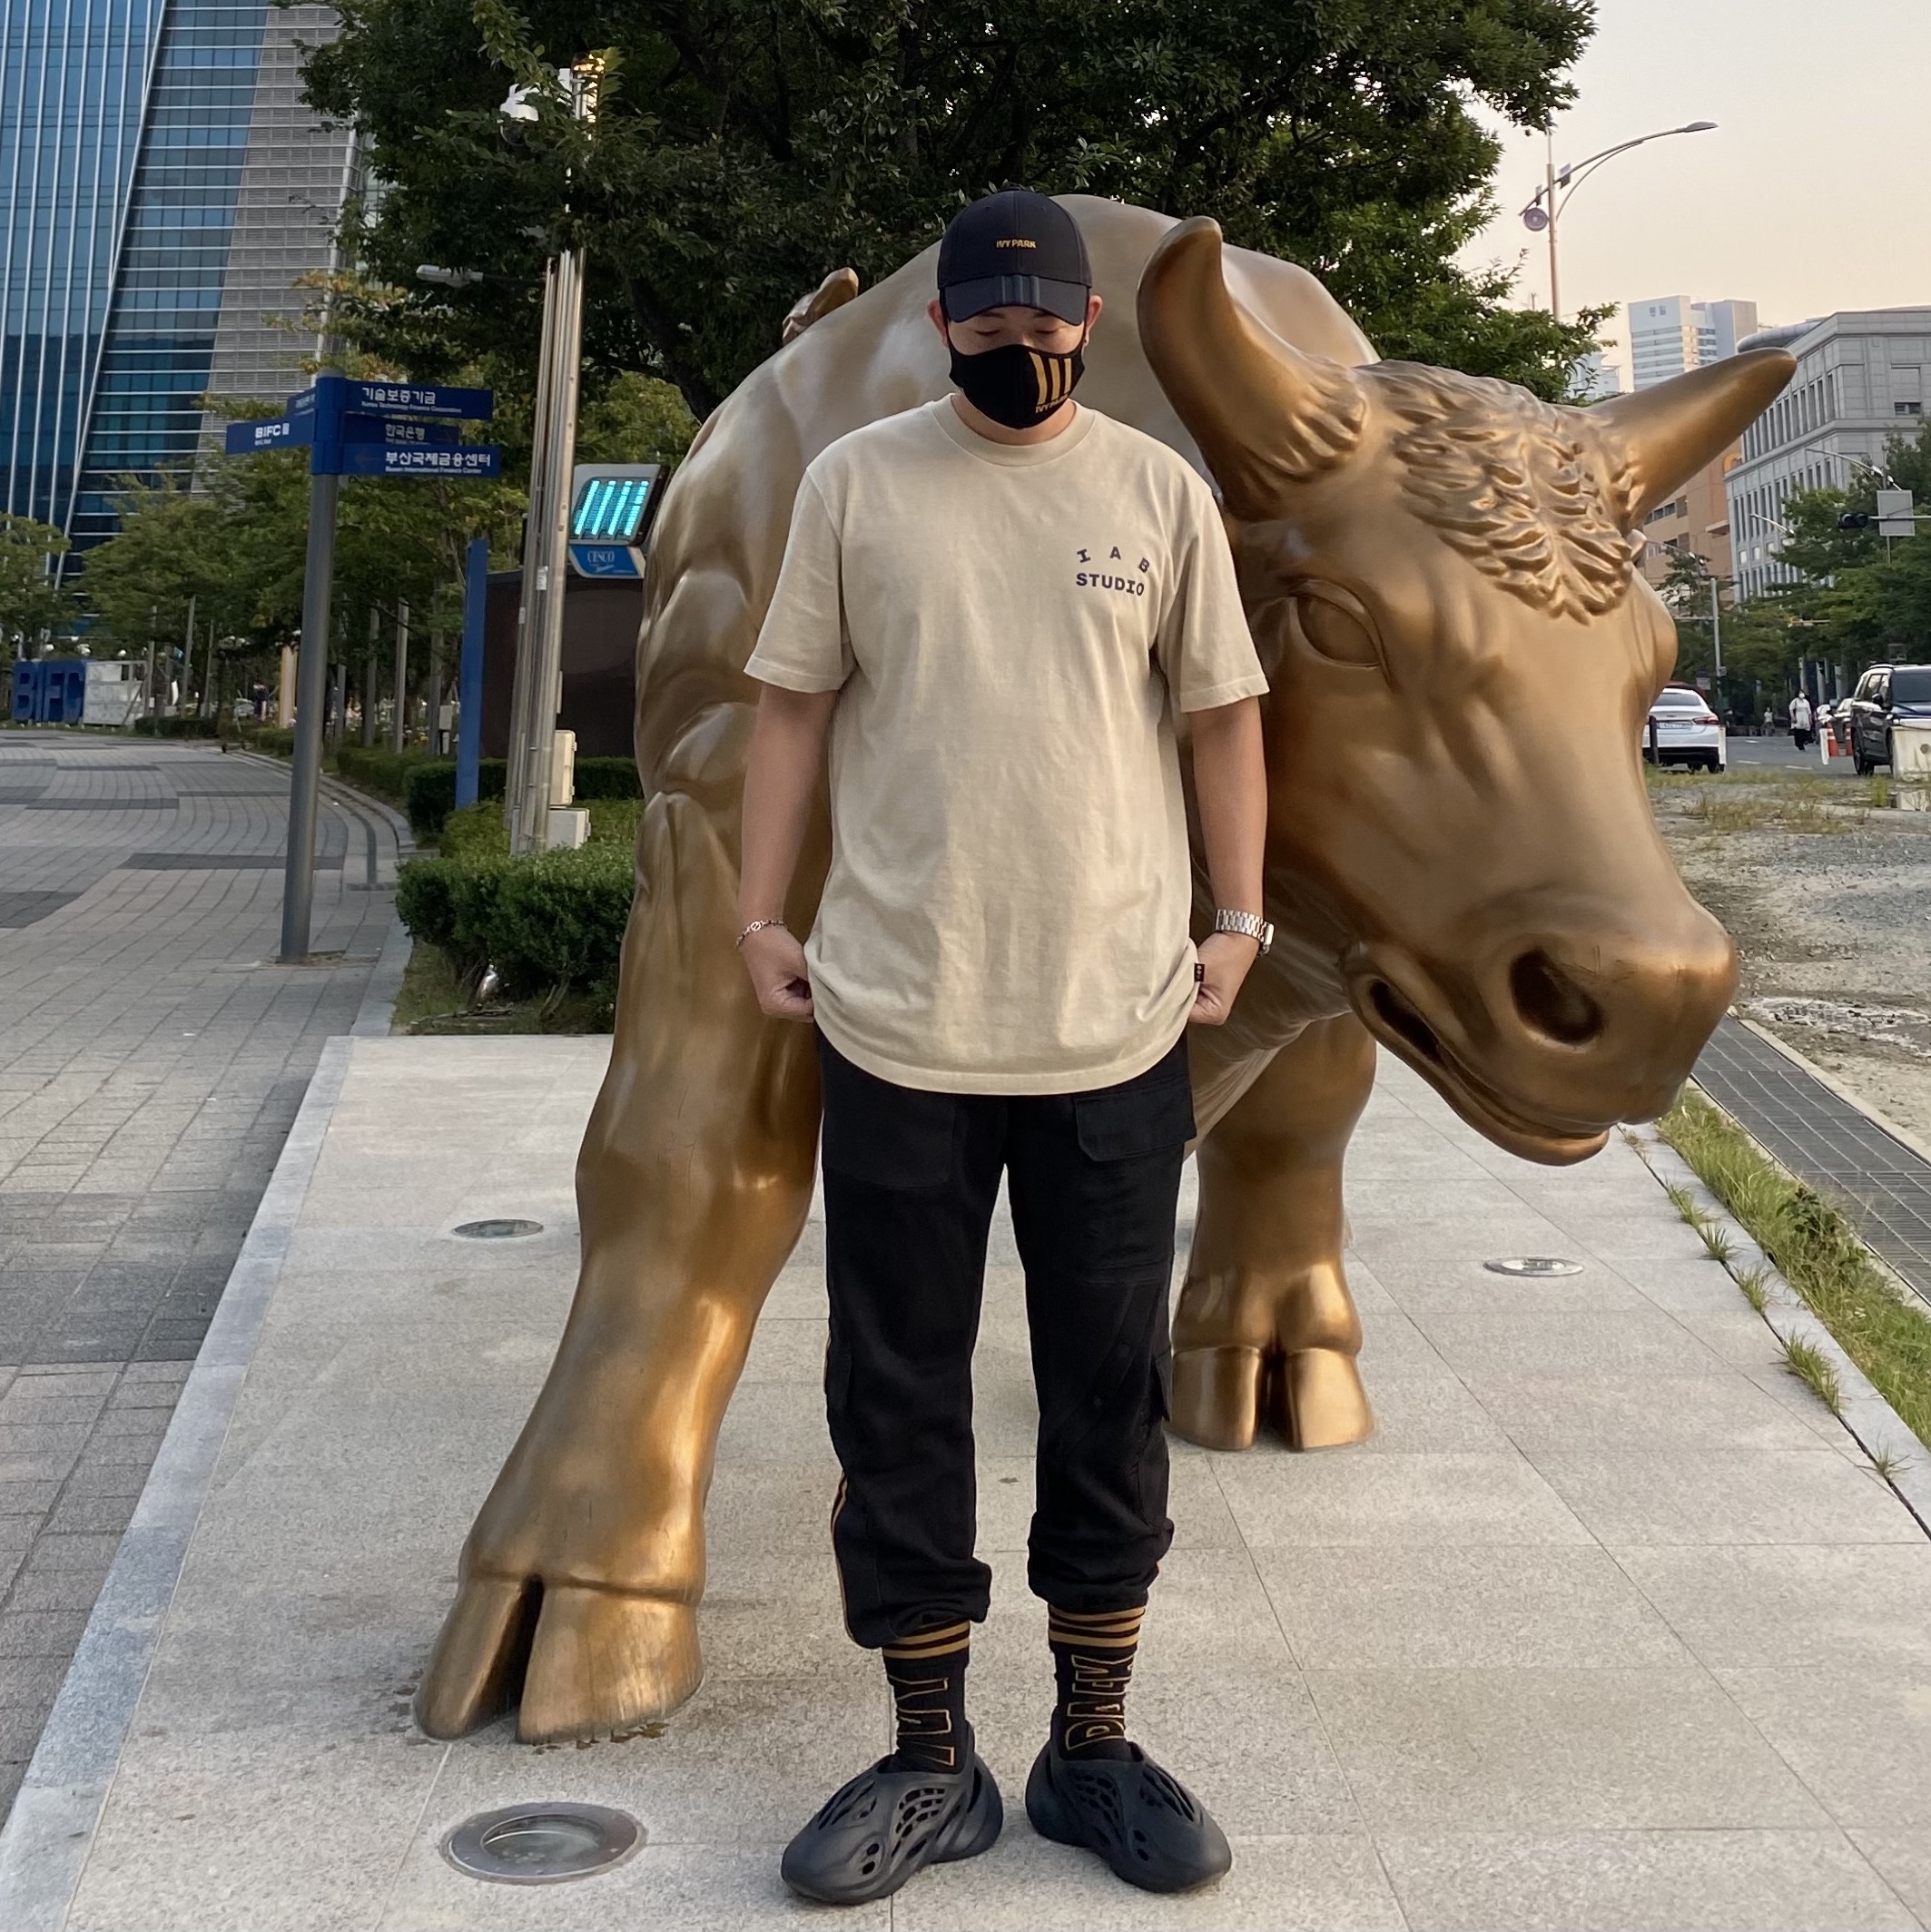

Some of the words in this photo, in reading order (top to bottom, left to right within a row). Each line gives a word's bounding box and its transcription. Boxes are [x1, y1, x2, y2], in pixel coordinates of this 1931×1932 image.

[996, 240, 1010, 249] IVY
[1011, 239, 1037, 249] PARK
[361, 387, 437, 405] 기술보증기금
[385, 423, 425, 441] 한국은행
[385, 451, 491, 468] 부산국제금융센터
[1076, 572, 1145, 596] STUDIO
